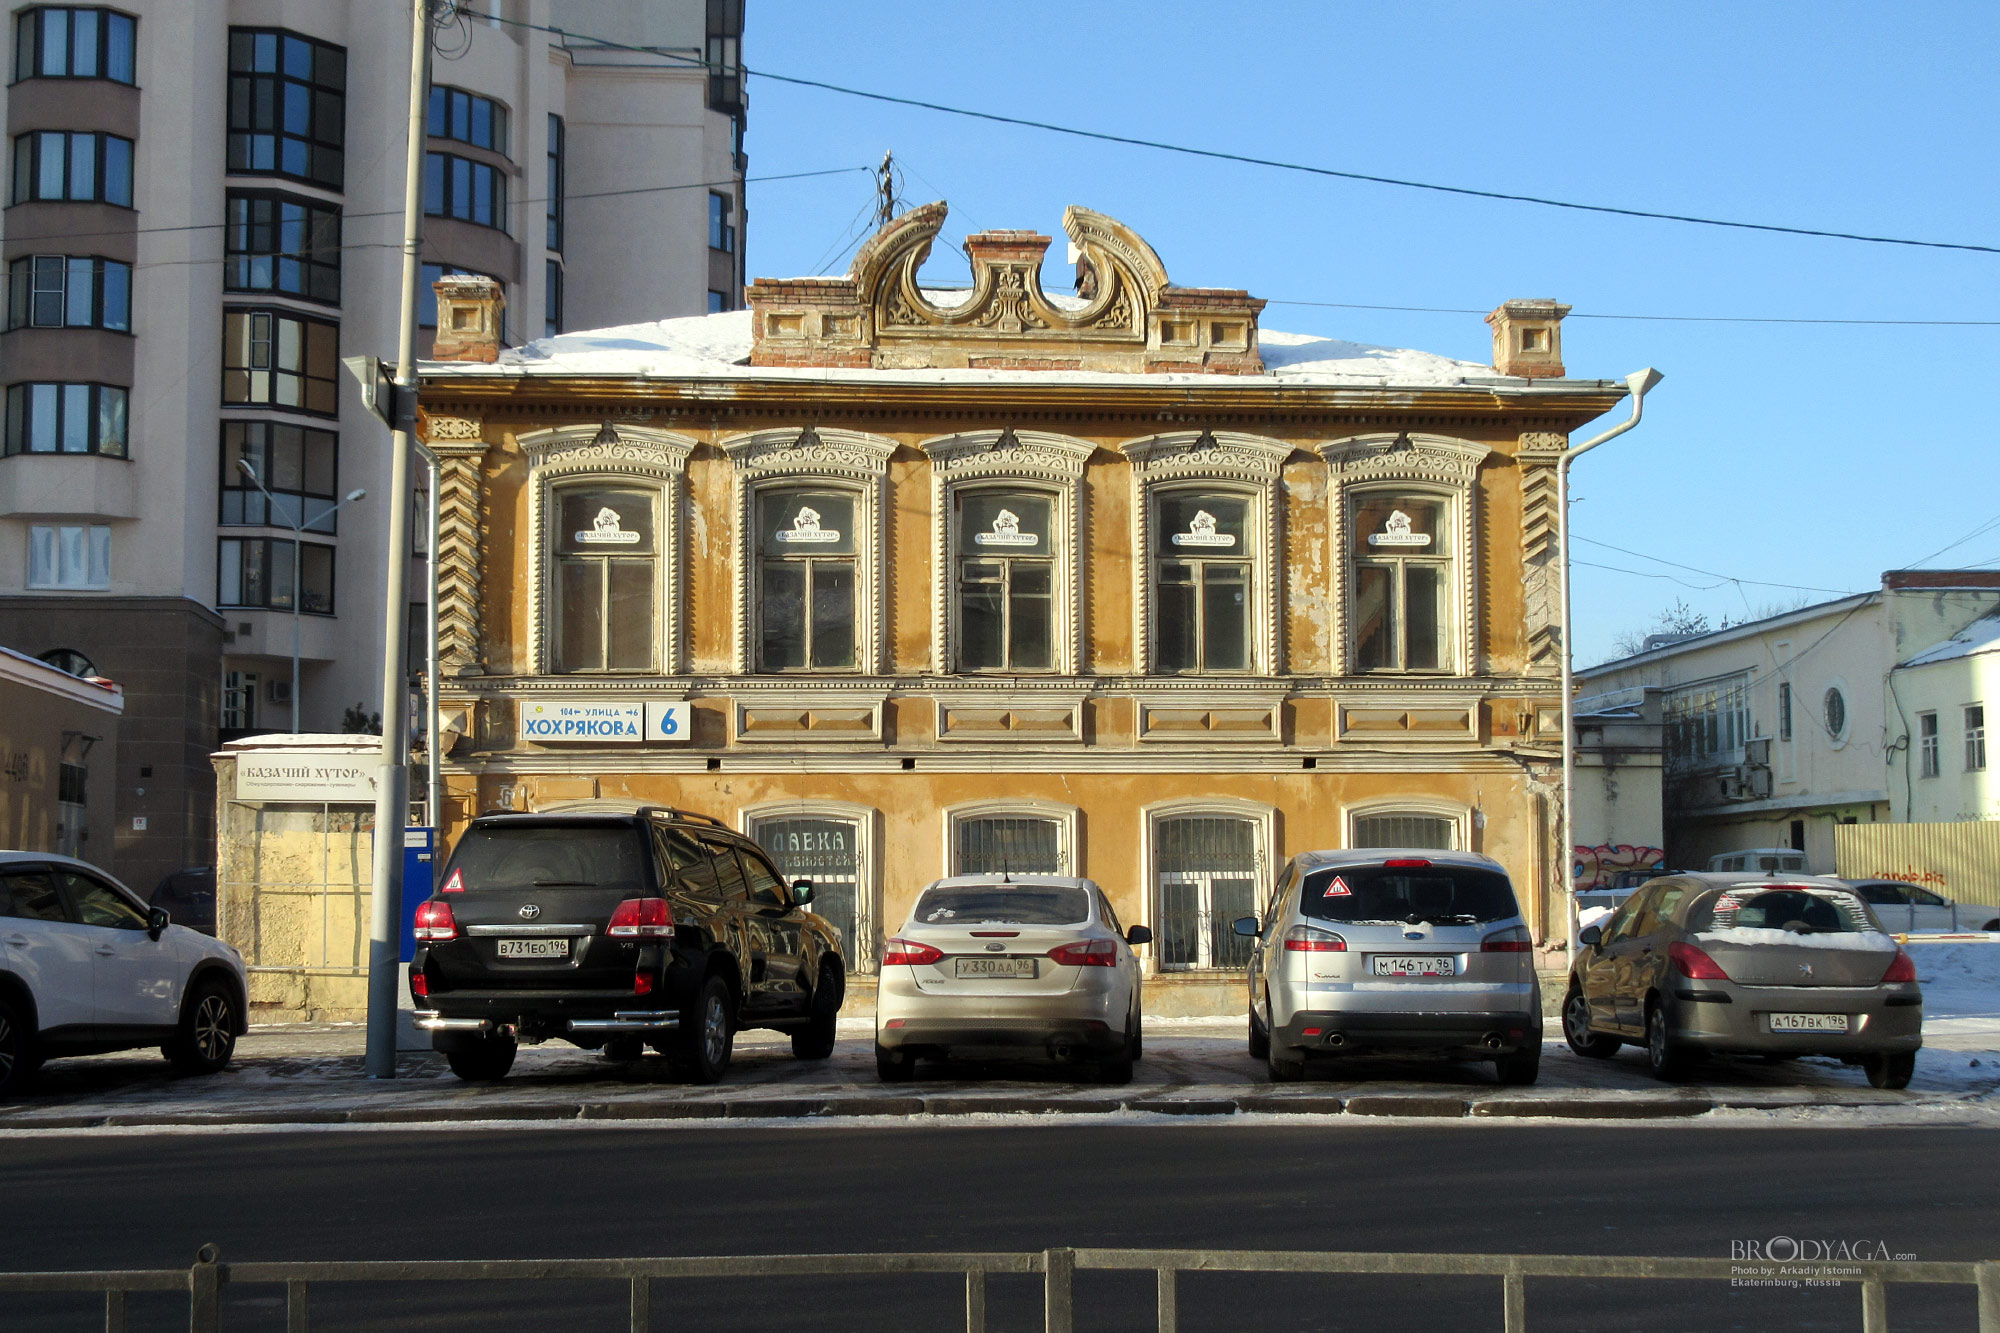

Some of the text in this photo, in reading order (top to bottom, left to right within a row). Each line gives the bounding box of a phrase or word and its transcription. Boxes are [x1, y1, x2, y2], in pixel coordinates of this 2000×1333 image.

[560, 708, 573, 716] 104
[585, 709, 620, 717] УЛИЦА
[525, 719, 638, 736] ХОХРЯКОВА
[660, 708, 678, 735] 6
[773, 831, 845, 851] ЛАВКА
[771, 853, 851, 867] РЕВНОСТЕЙ
